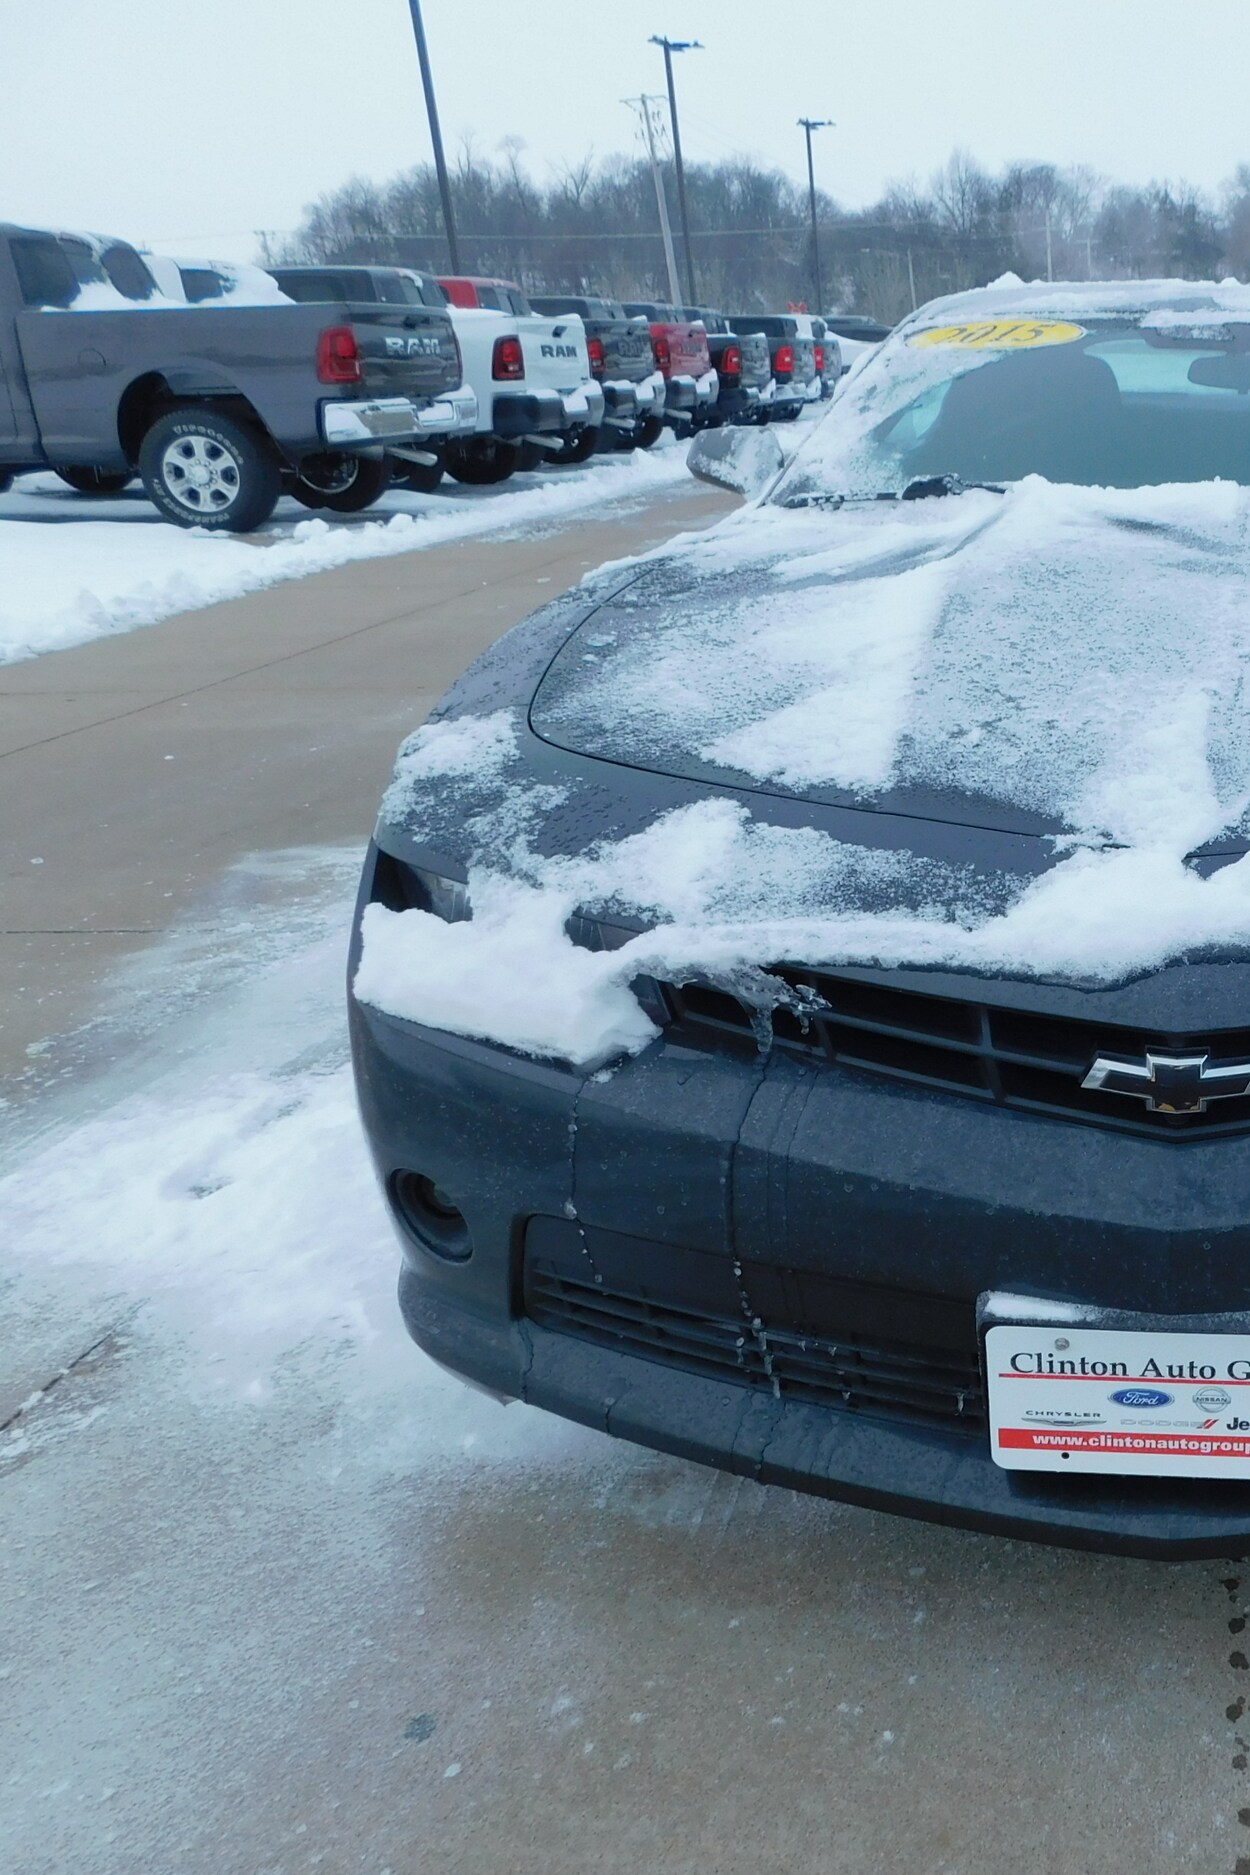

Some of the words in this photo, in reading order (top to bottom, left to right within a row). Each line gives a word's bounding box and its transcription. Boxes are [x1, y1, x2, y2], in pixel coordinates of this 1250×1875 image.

[935, 323, 1057, 344] 2015
[385, 337, 440, 355] RAM
[540, 344, 577, 358] RAM
[1010, 1352, 1129, 1376] Clinton
[1139, 1358, 1216, 1380] Auto
[1122, 1391, 1159, 1405] Ford
[1025, 1410, 1101, 1418] CHRYSLER
